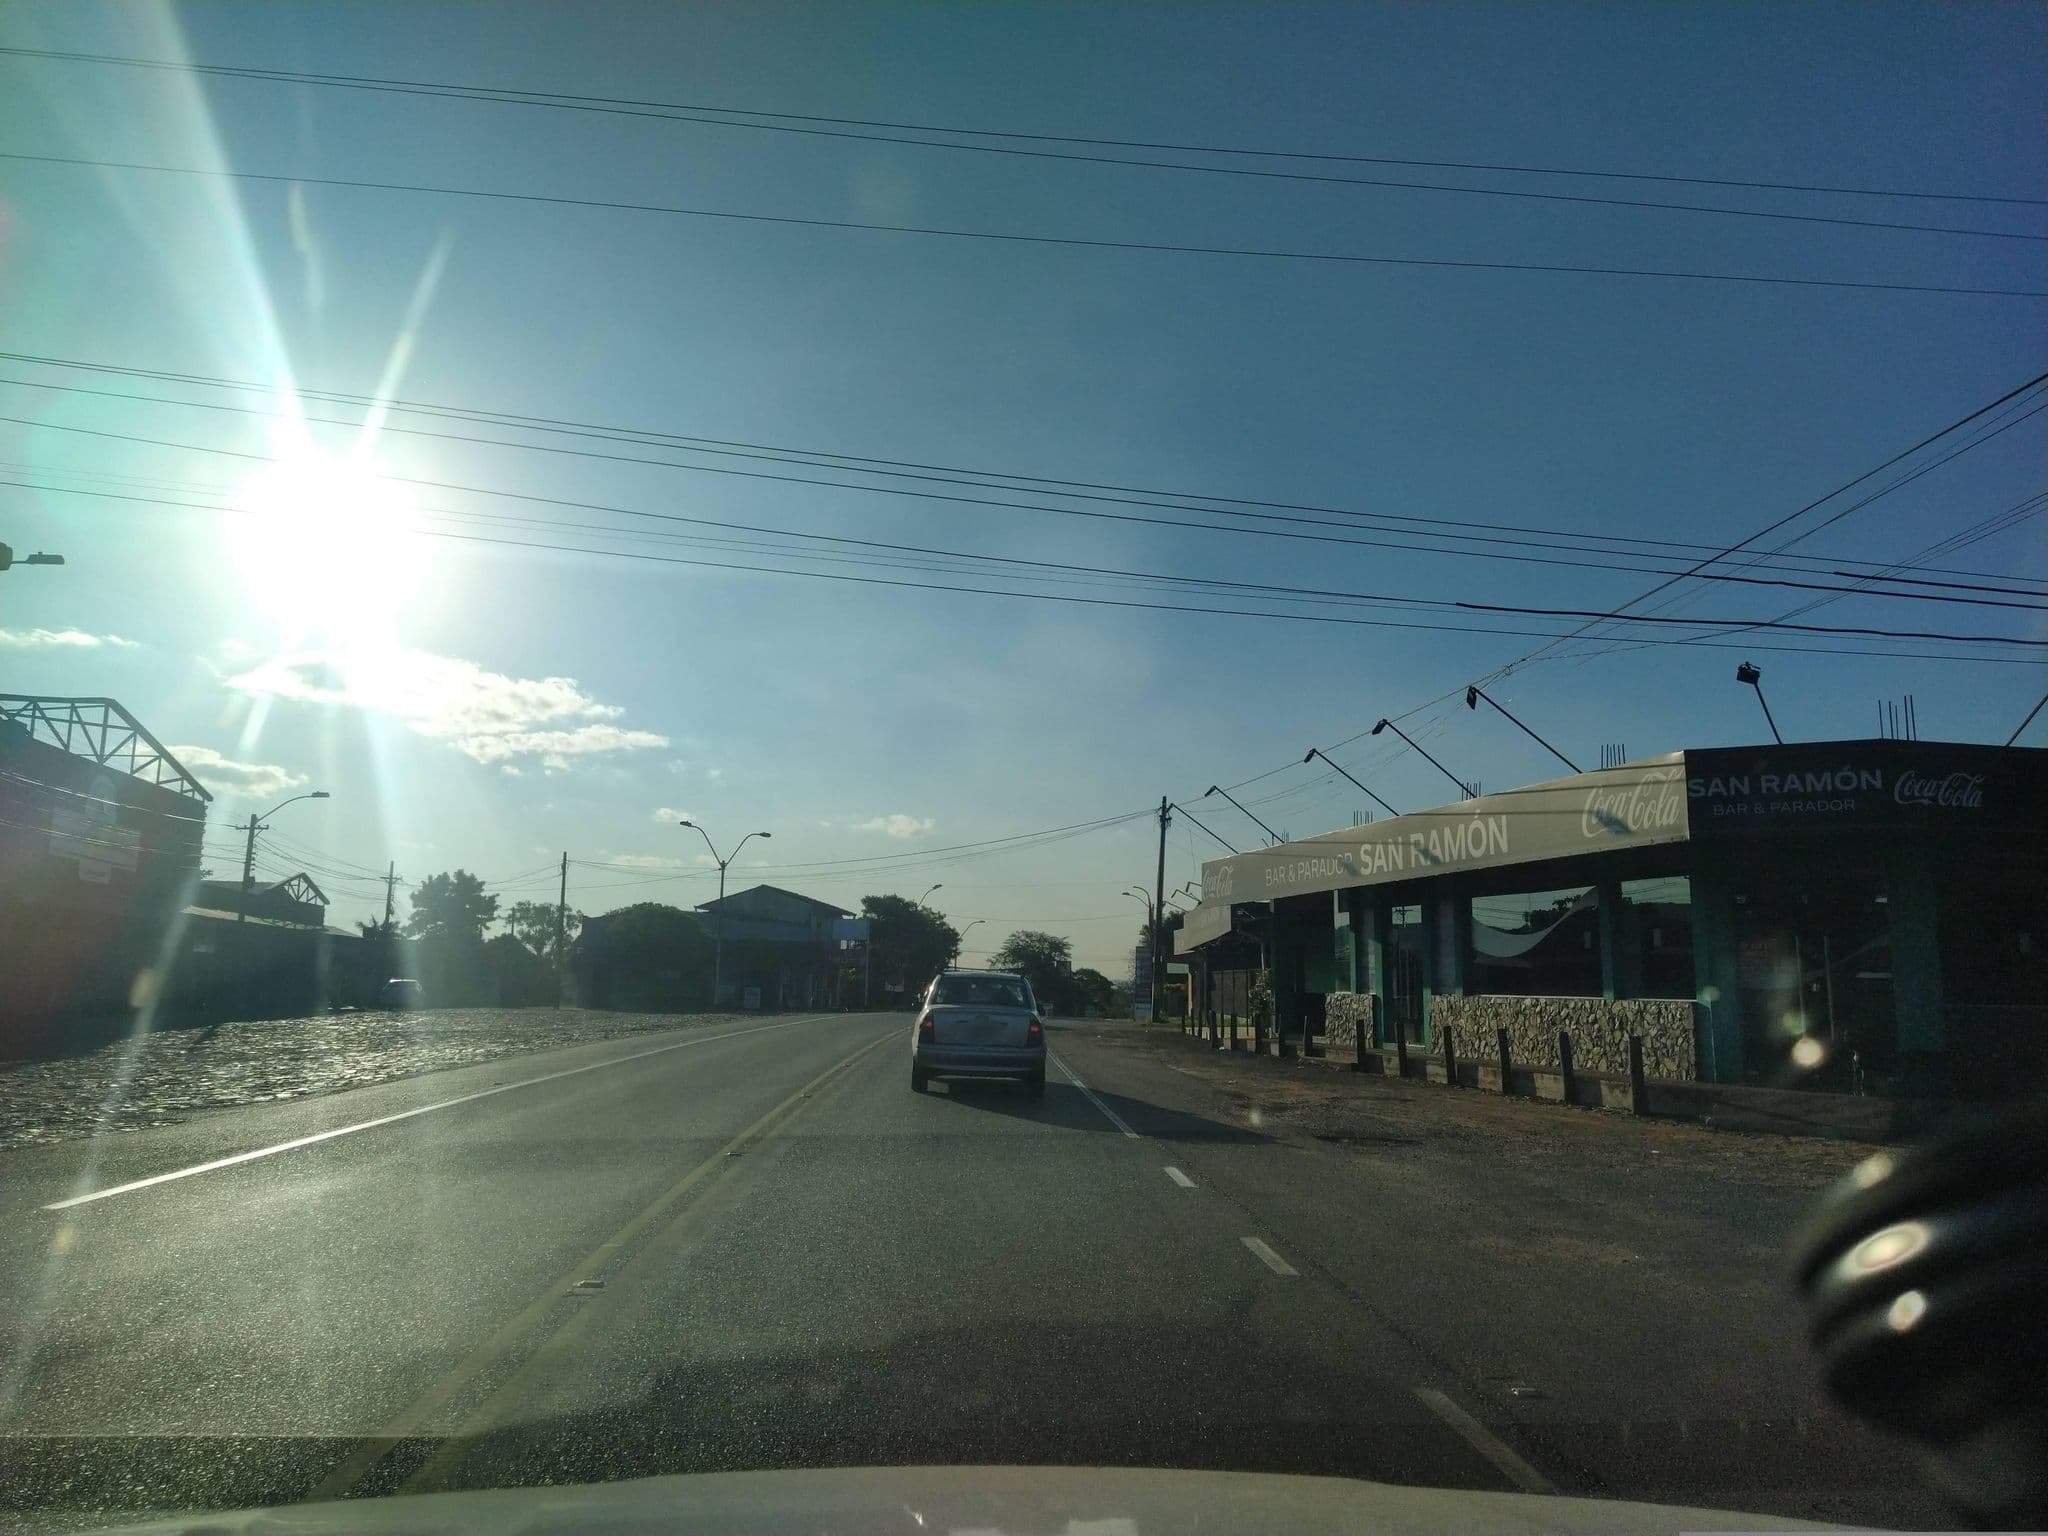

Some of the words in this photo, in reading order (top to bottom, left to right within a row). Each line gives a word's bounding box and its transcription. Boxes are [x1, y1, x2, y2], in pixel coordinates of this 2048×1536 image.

[1687, 774, 1750, 798] SAN
[1760, 765, 1882, 794] RAMÓN
[1894, 769, 1985, 808] Coca-Cola
[1582, 768, 1685, 838] Coca-Cola
[1713, 801, 1748, 816] BAR
[1753, 802, 1767, 815] &
[1770, 799, 1856, 813] PARADOR
[1265, 865, 1286, 886] BAR
[1288, 865, 1296, 882] &
[1297, 853, 1353, 879] PARADOR
[1359, 835, 1404, 876] SAN
[1409, 809, 1510, 867] RAMÓN
